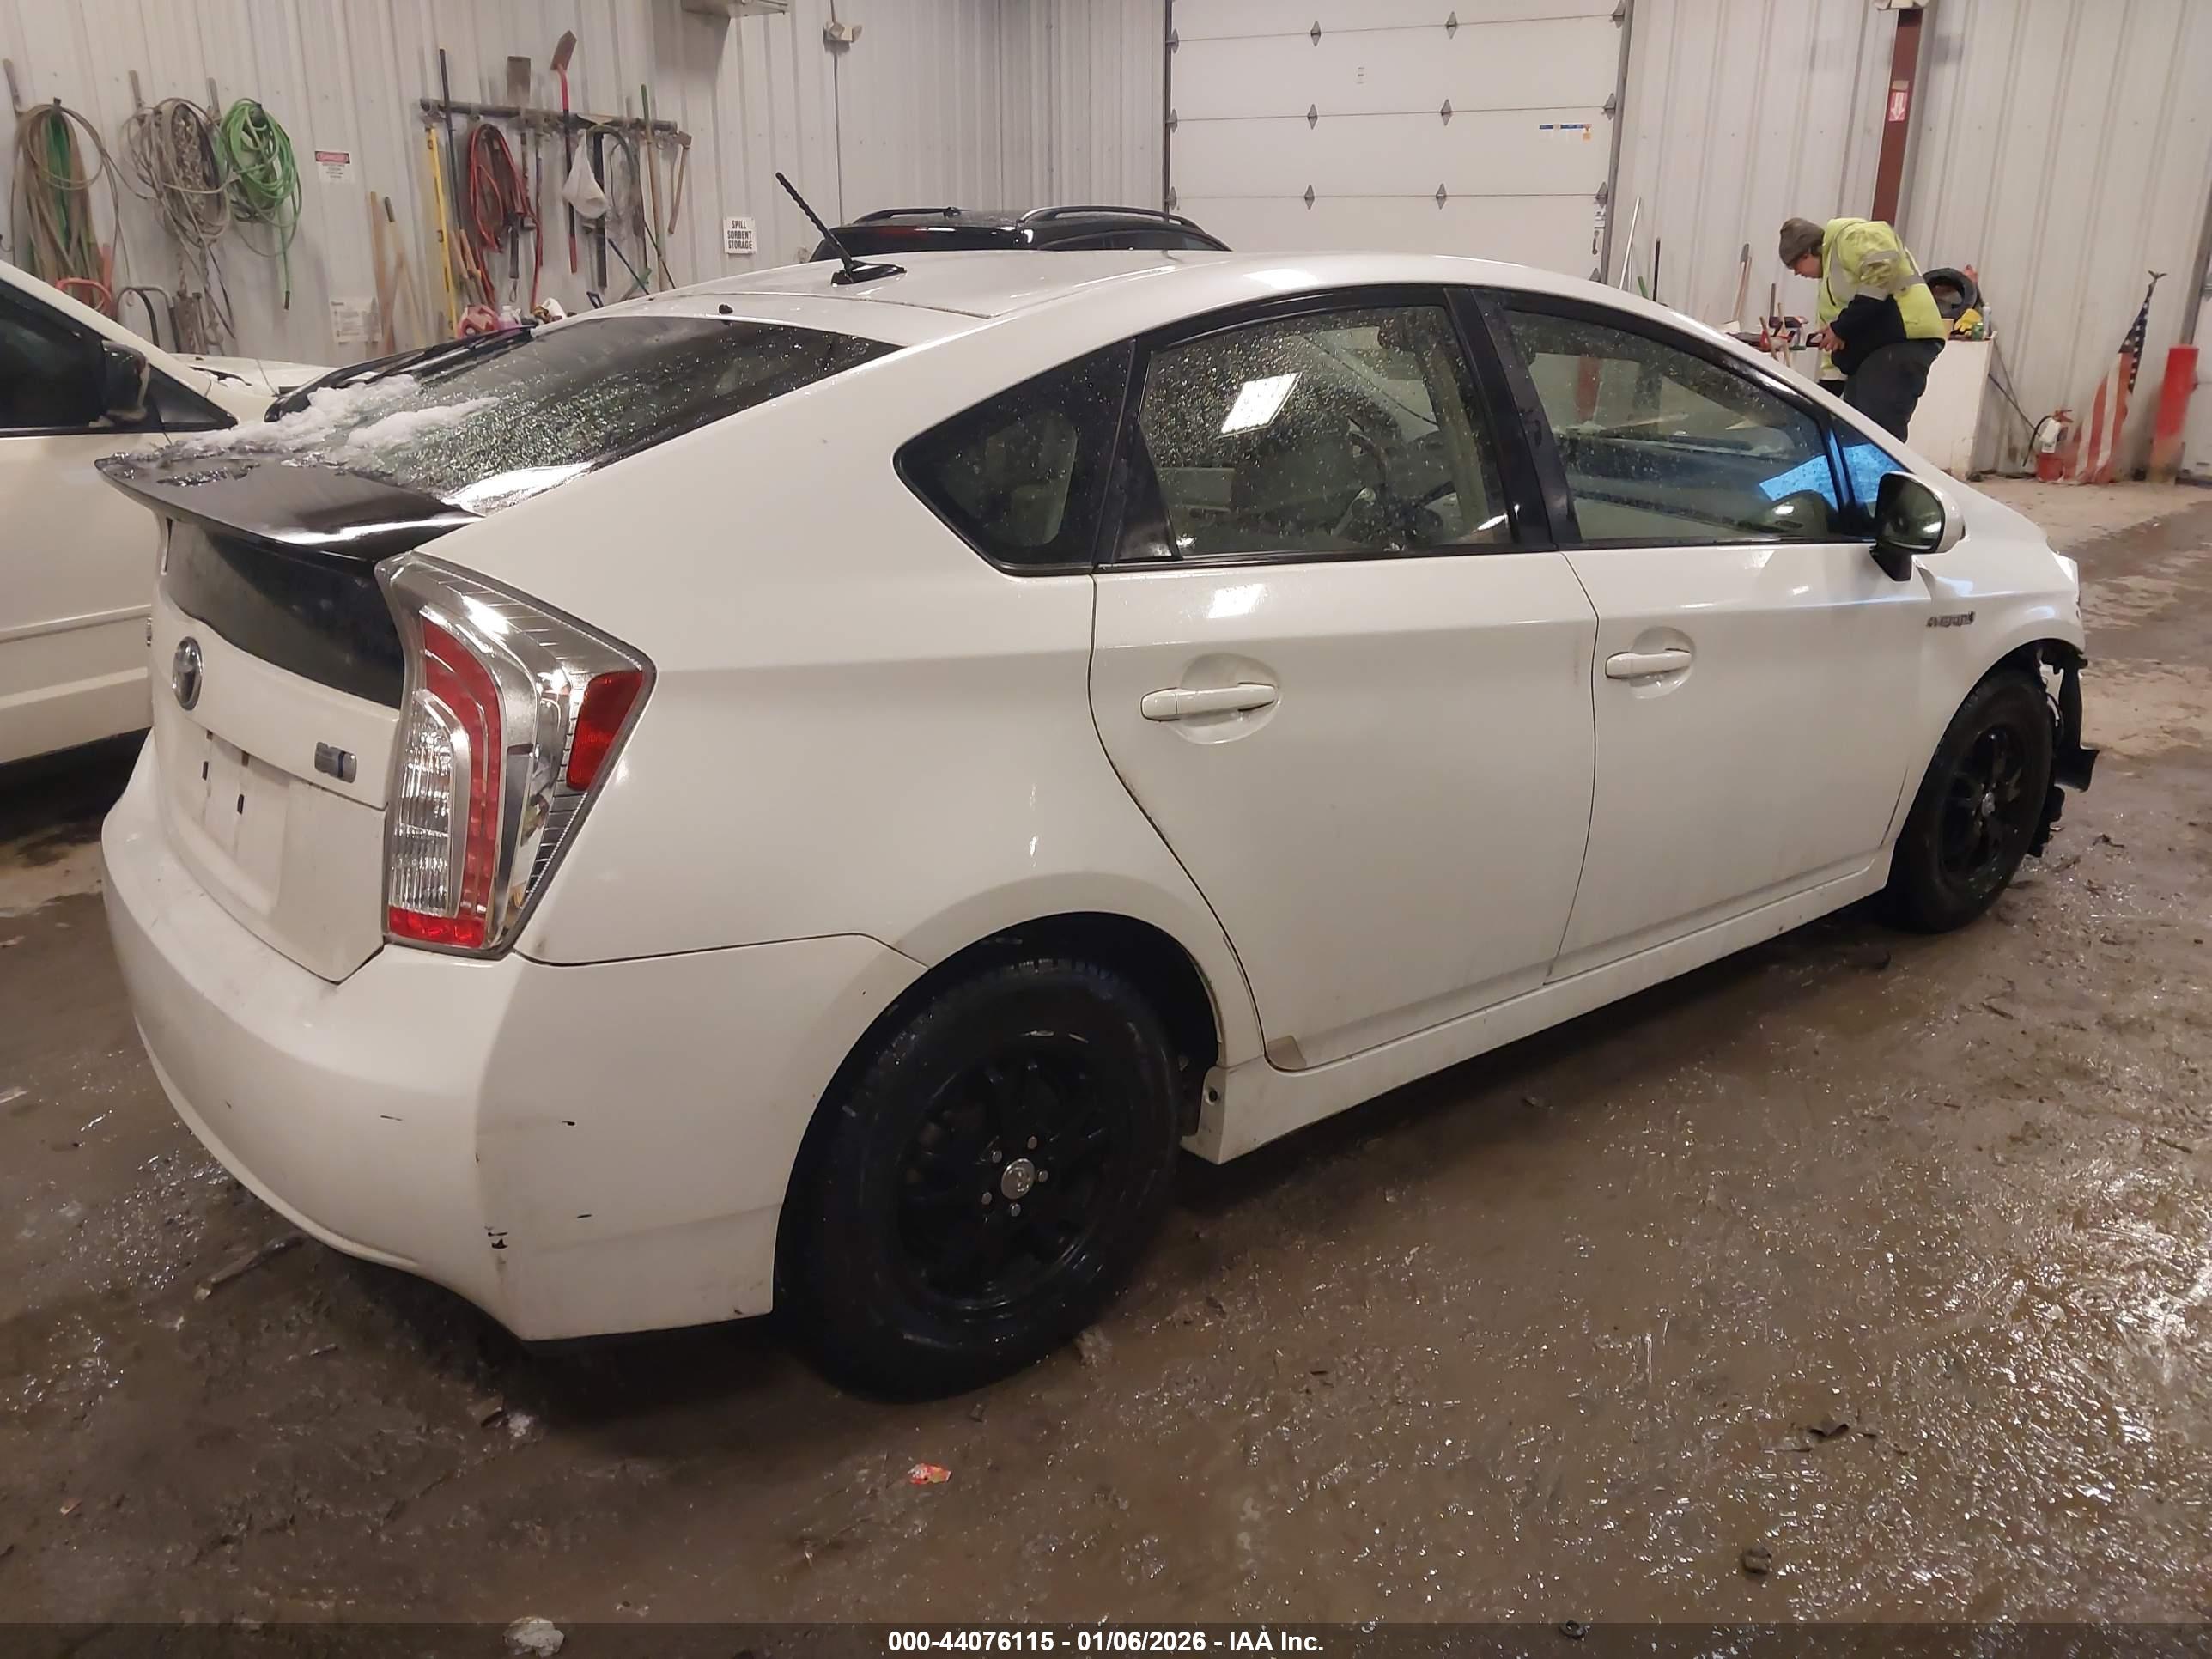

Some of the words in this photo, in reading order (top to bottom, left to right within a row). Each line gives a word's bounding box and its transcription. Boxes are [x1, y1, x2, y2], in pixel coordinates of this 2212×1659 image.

[732, 220, 746, 229] SPILL
[727, 230, 751, 240] SORBENT
[728, 240, 752, 249] STORAGE
